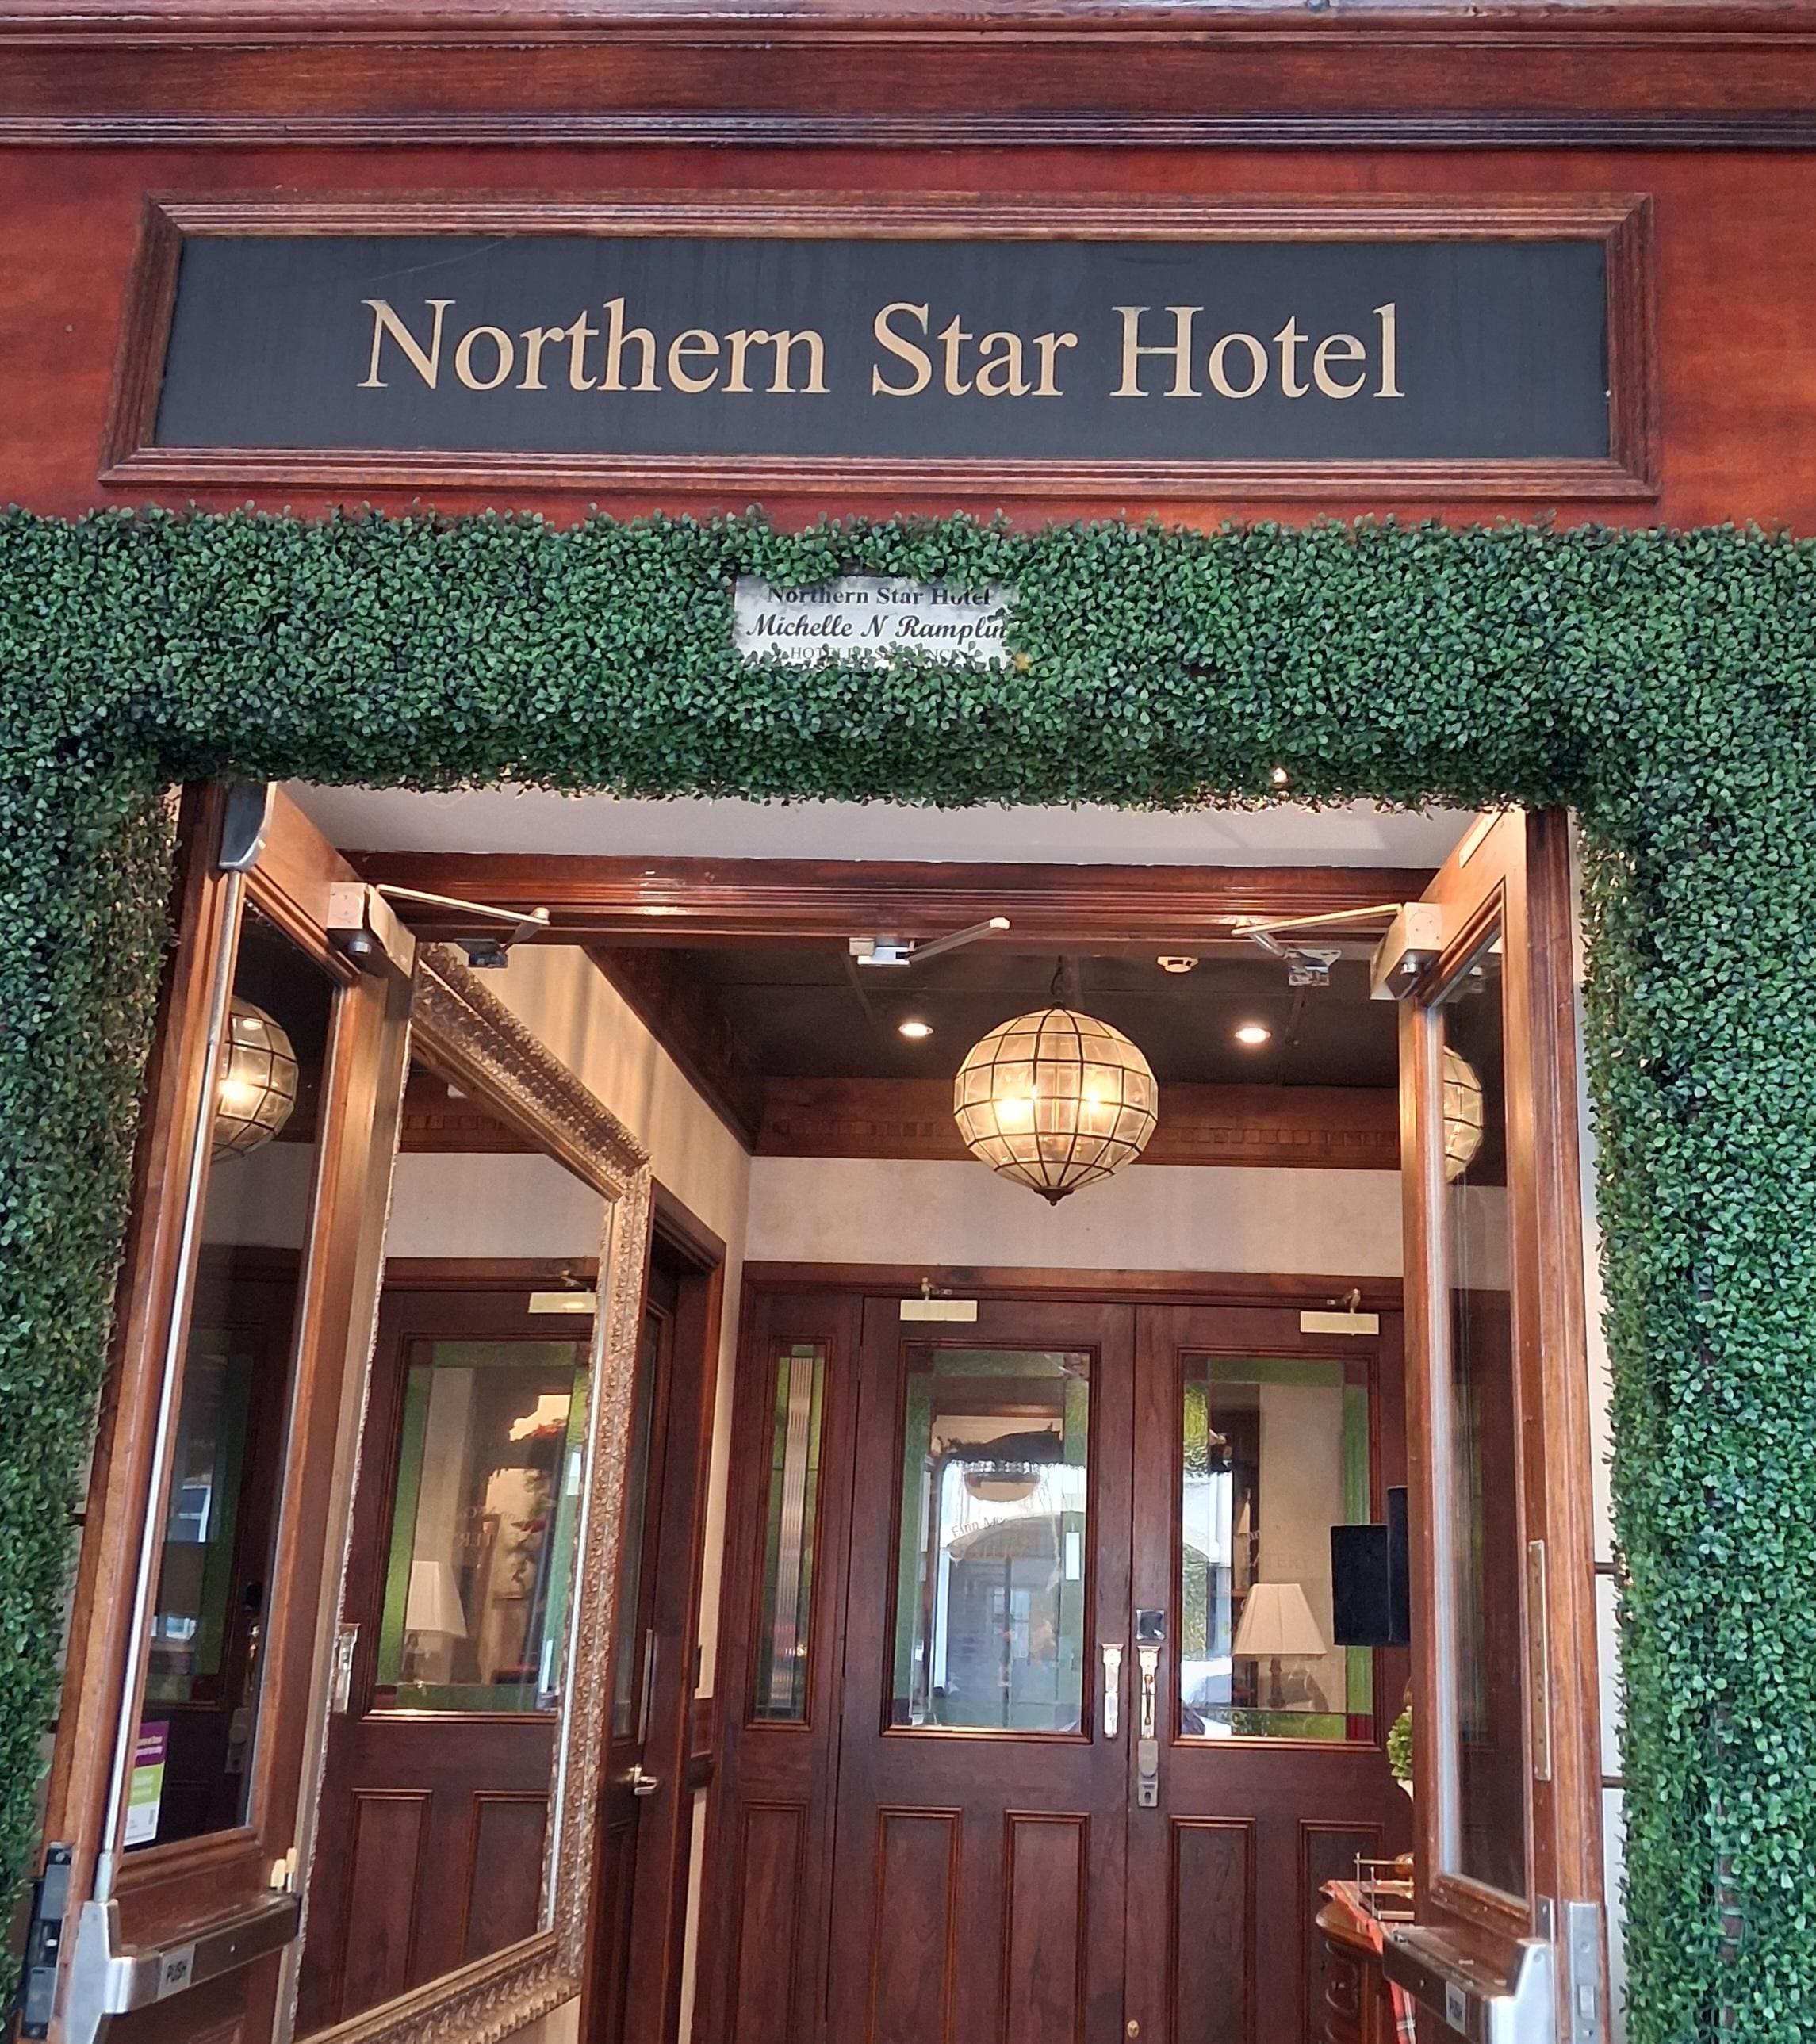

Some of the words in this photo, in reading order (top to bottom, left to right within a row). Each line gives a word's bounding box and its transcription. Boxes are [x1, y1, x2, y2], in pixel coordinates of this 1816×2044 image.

[357, 297, 831, 392] Northern
[872, 302, 1078, 396] Star
[1110, 303, 1404, 398] Hotel
[767, 586, 869, 603] Northern
[876, 588, 923, 605] Star
[746, 613, 853, 638] Michelle
[860, 614, 887, 638] N
